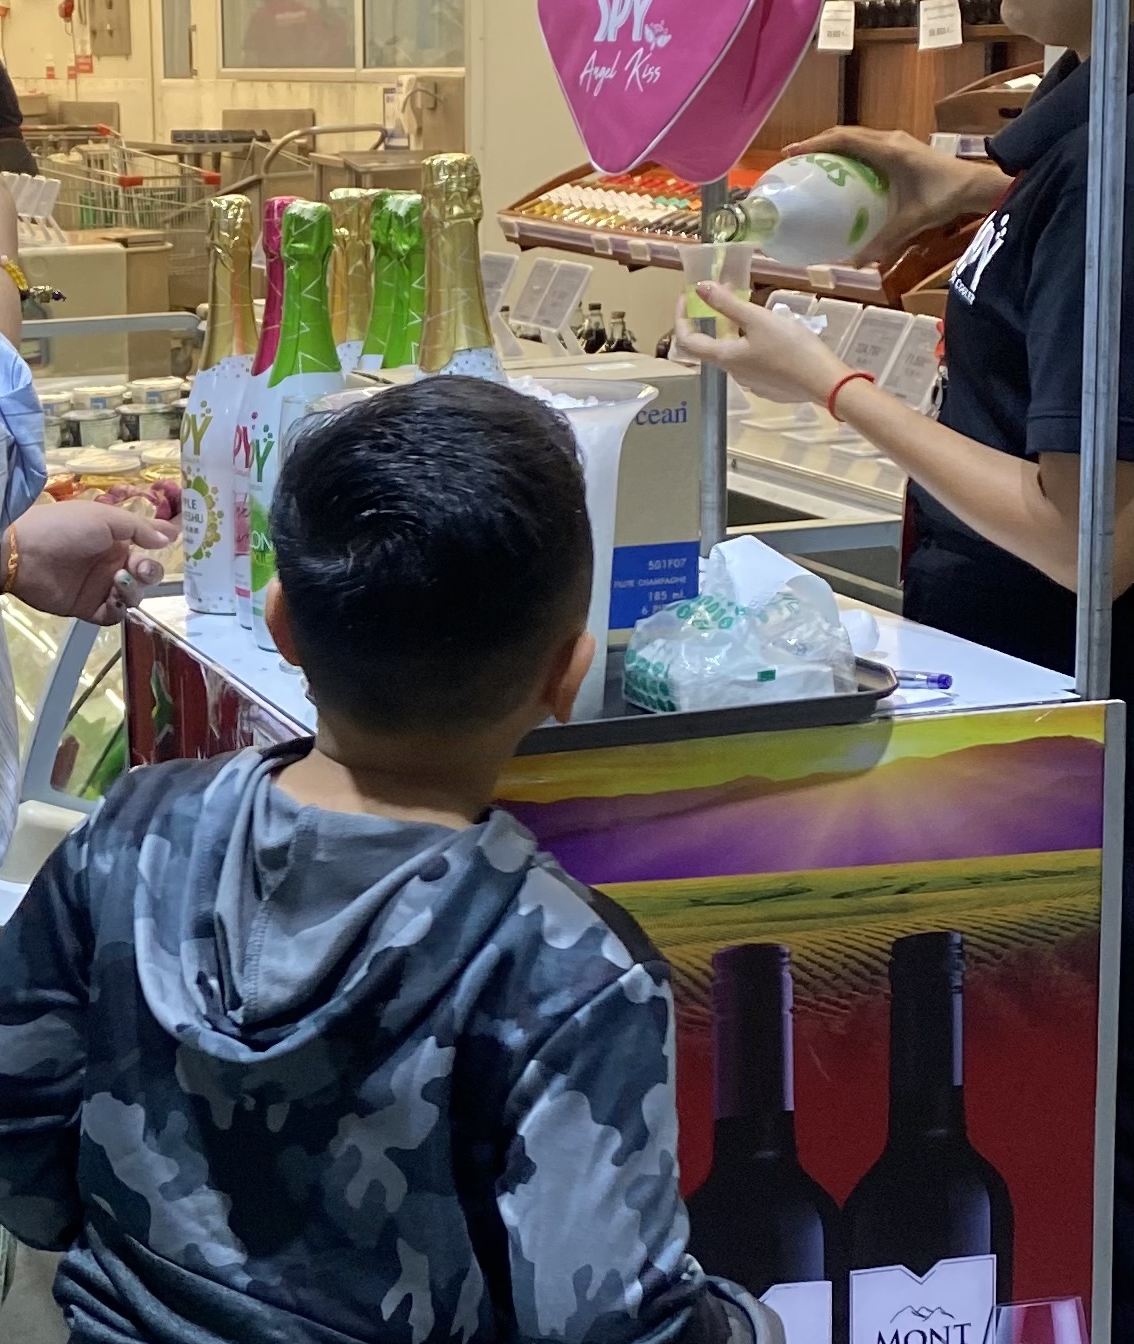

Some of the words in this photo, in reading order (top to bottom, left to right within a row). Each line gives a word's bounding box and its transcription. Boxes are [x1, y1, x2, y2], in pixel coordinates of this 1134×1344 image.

[579, 50, 622, 97] Angel
[624, 47, 662, 93] Kiss
[635, 401, 687, 426] cean
